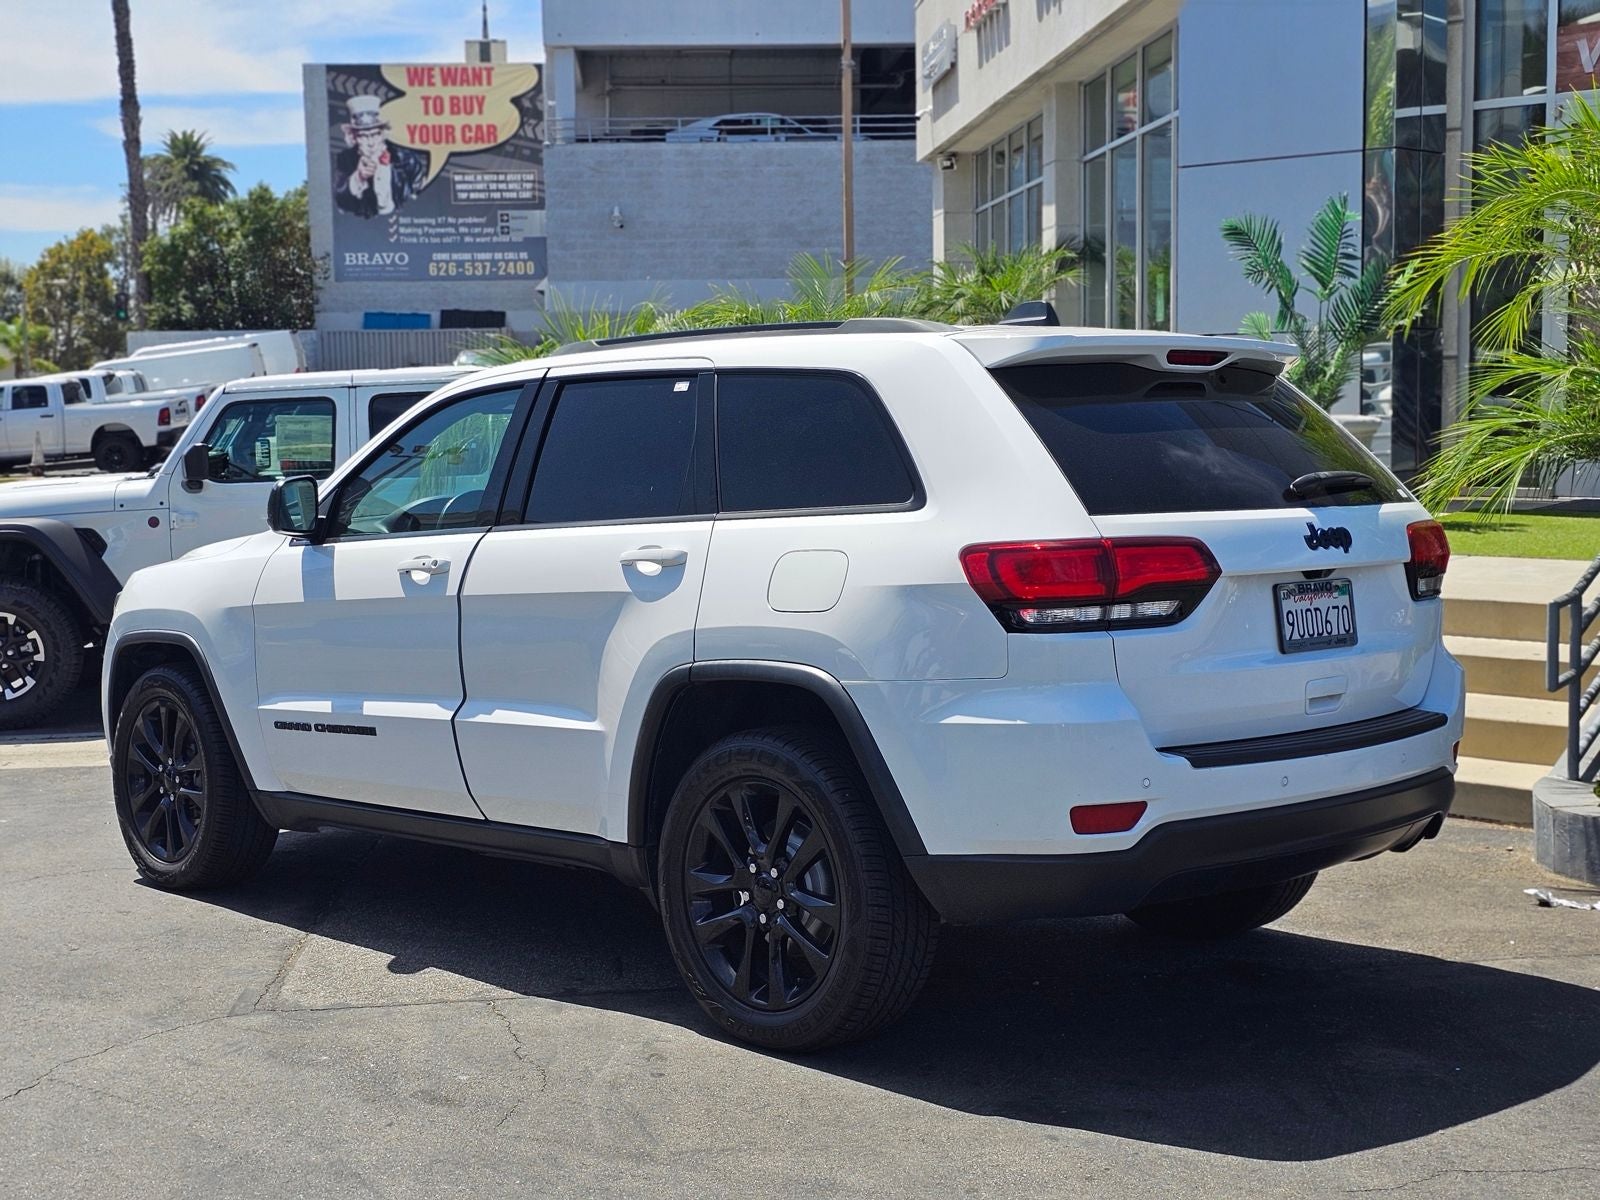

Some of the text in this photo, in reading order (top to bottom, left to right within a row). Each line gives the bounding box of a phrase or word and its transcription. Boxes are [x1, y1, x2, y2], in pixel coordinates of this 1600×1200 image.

[406, 66, 494, 87] WE WANT
[421, 95, 486, 116] TO BUY
[406, 124, 498, 145] YOUR CAR
[344, 253, 409, 266] BRAVO
[504, 252, 518, 260] CALL
[429, 261, 534, 277] 626-537-2400
[1304, 522, 1353, 553] Jeep
[1297, 582, 1333, 594] BRAVO
[274, 721, 377, 736] GRAND CHEROKEE
